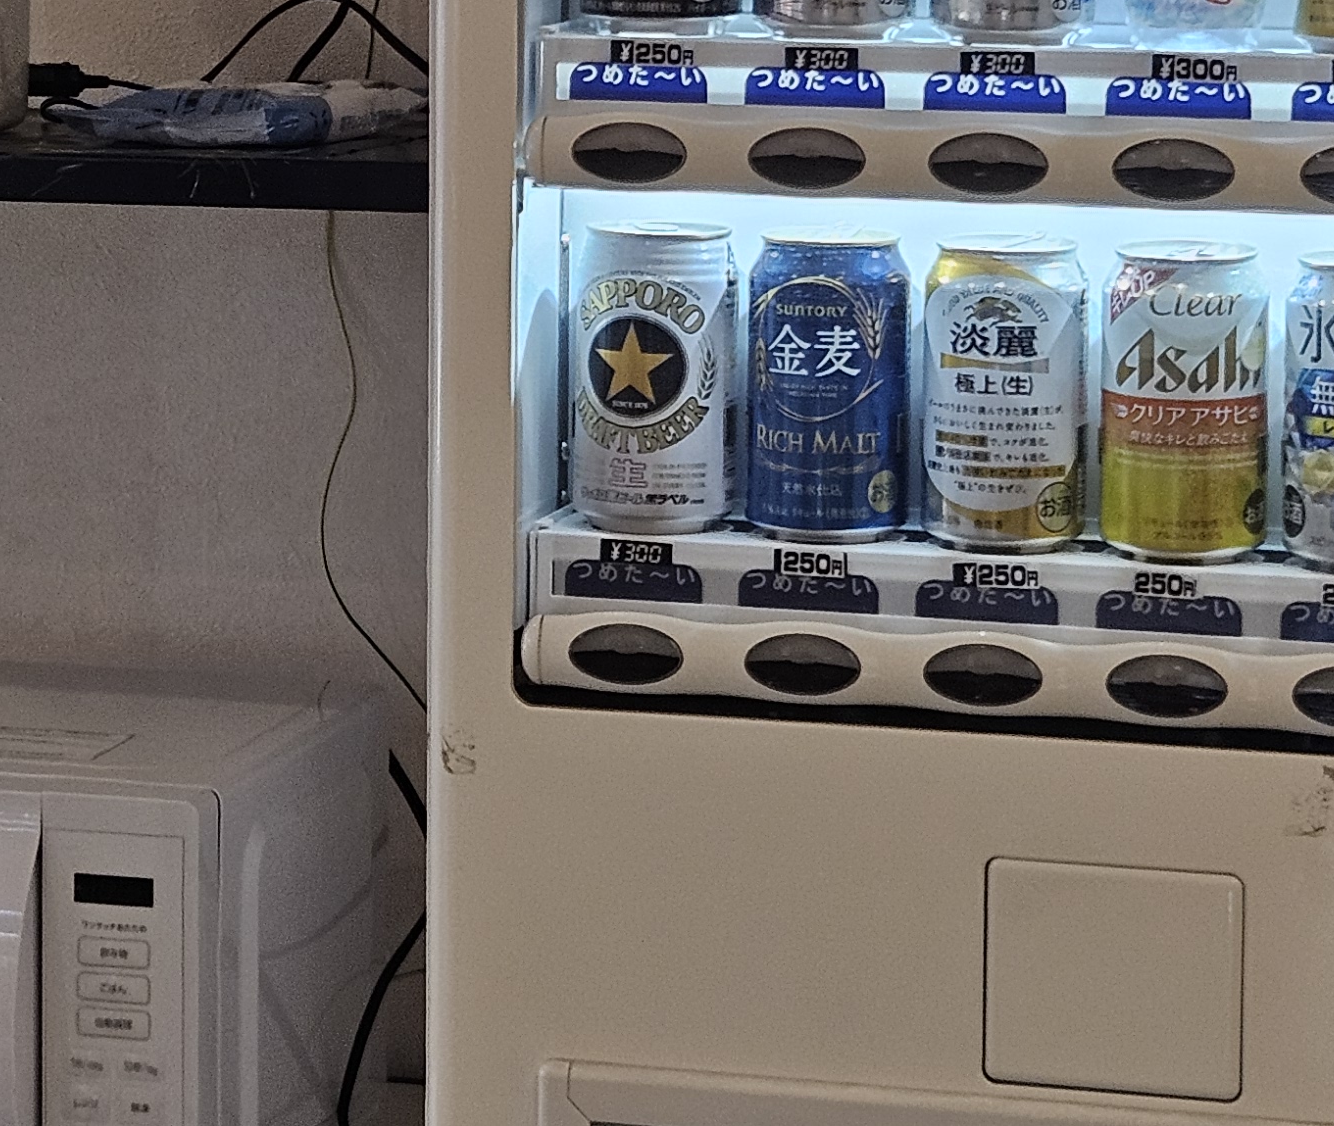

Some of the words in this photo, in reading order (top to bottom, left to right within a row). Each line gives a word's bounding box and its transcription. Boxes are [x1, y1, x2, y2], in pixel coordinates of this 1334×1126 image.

[795, 50, 848, 70] ¥300
[970, 54, 1025, 73] ¥300
[581, 278, 705, 334] SAPPORO
[776, 304, 847, 317] SUNTORY
[1149, 285, 1242, 316] Clear
[768, 324, 861, 377] 金麦
[950, 322, 1038, 357] 淡麗
[955, 373, 1034, 396] 極上(生)
[636, 396, 710, 454] BEER
[610, 458, 648, 488] 生
[610, 543, 662, 564] ¥300
[1134, 572, 1198, 597] 250円
